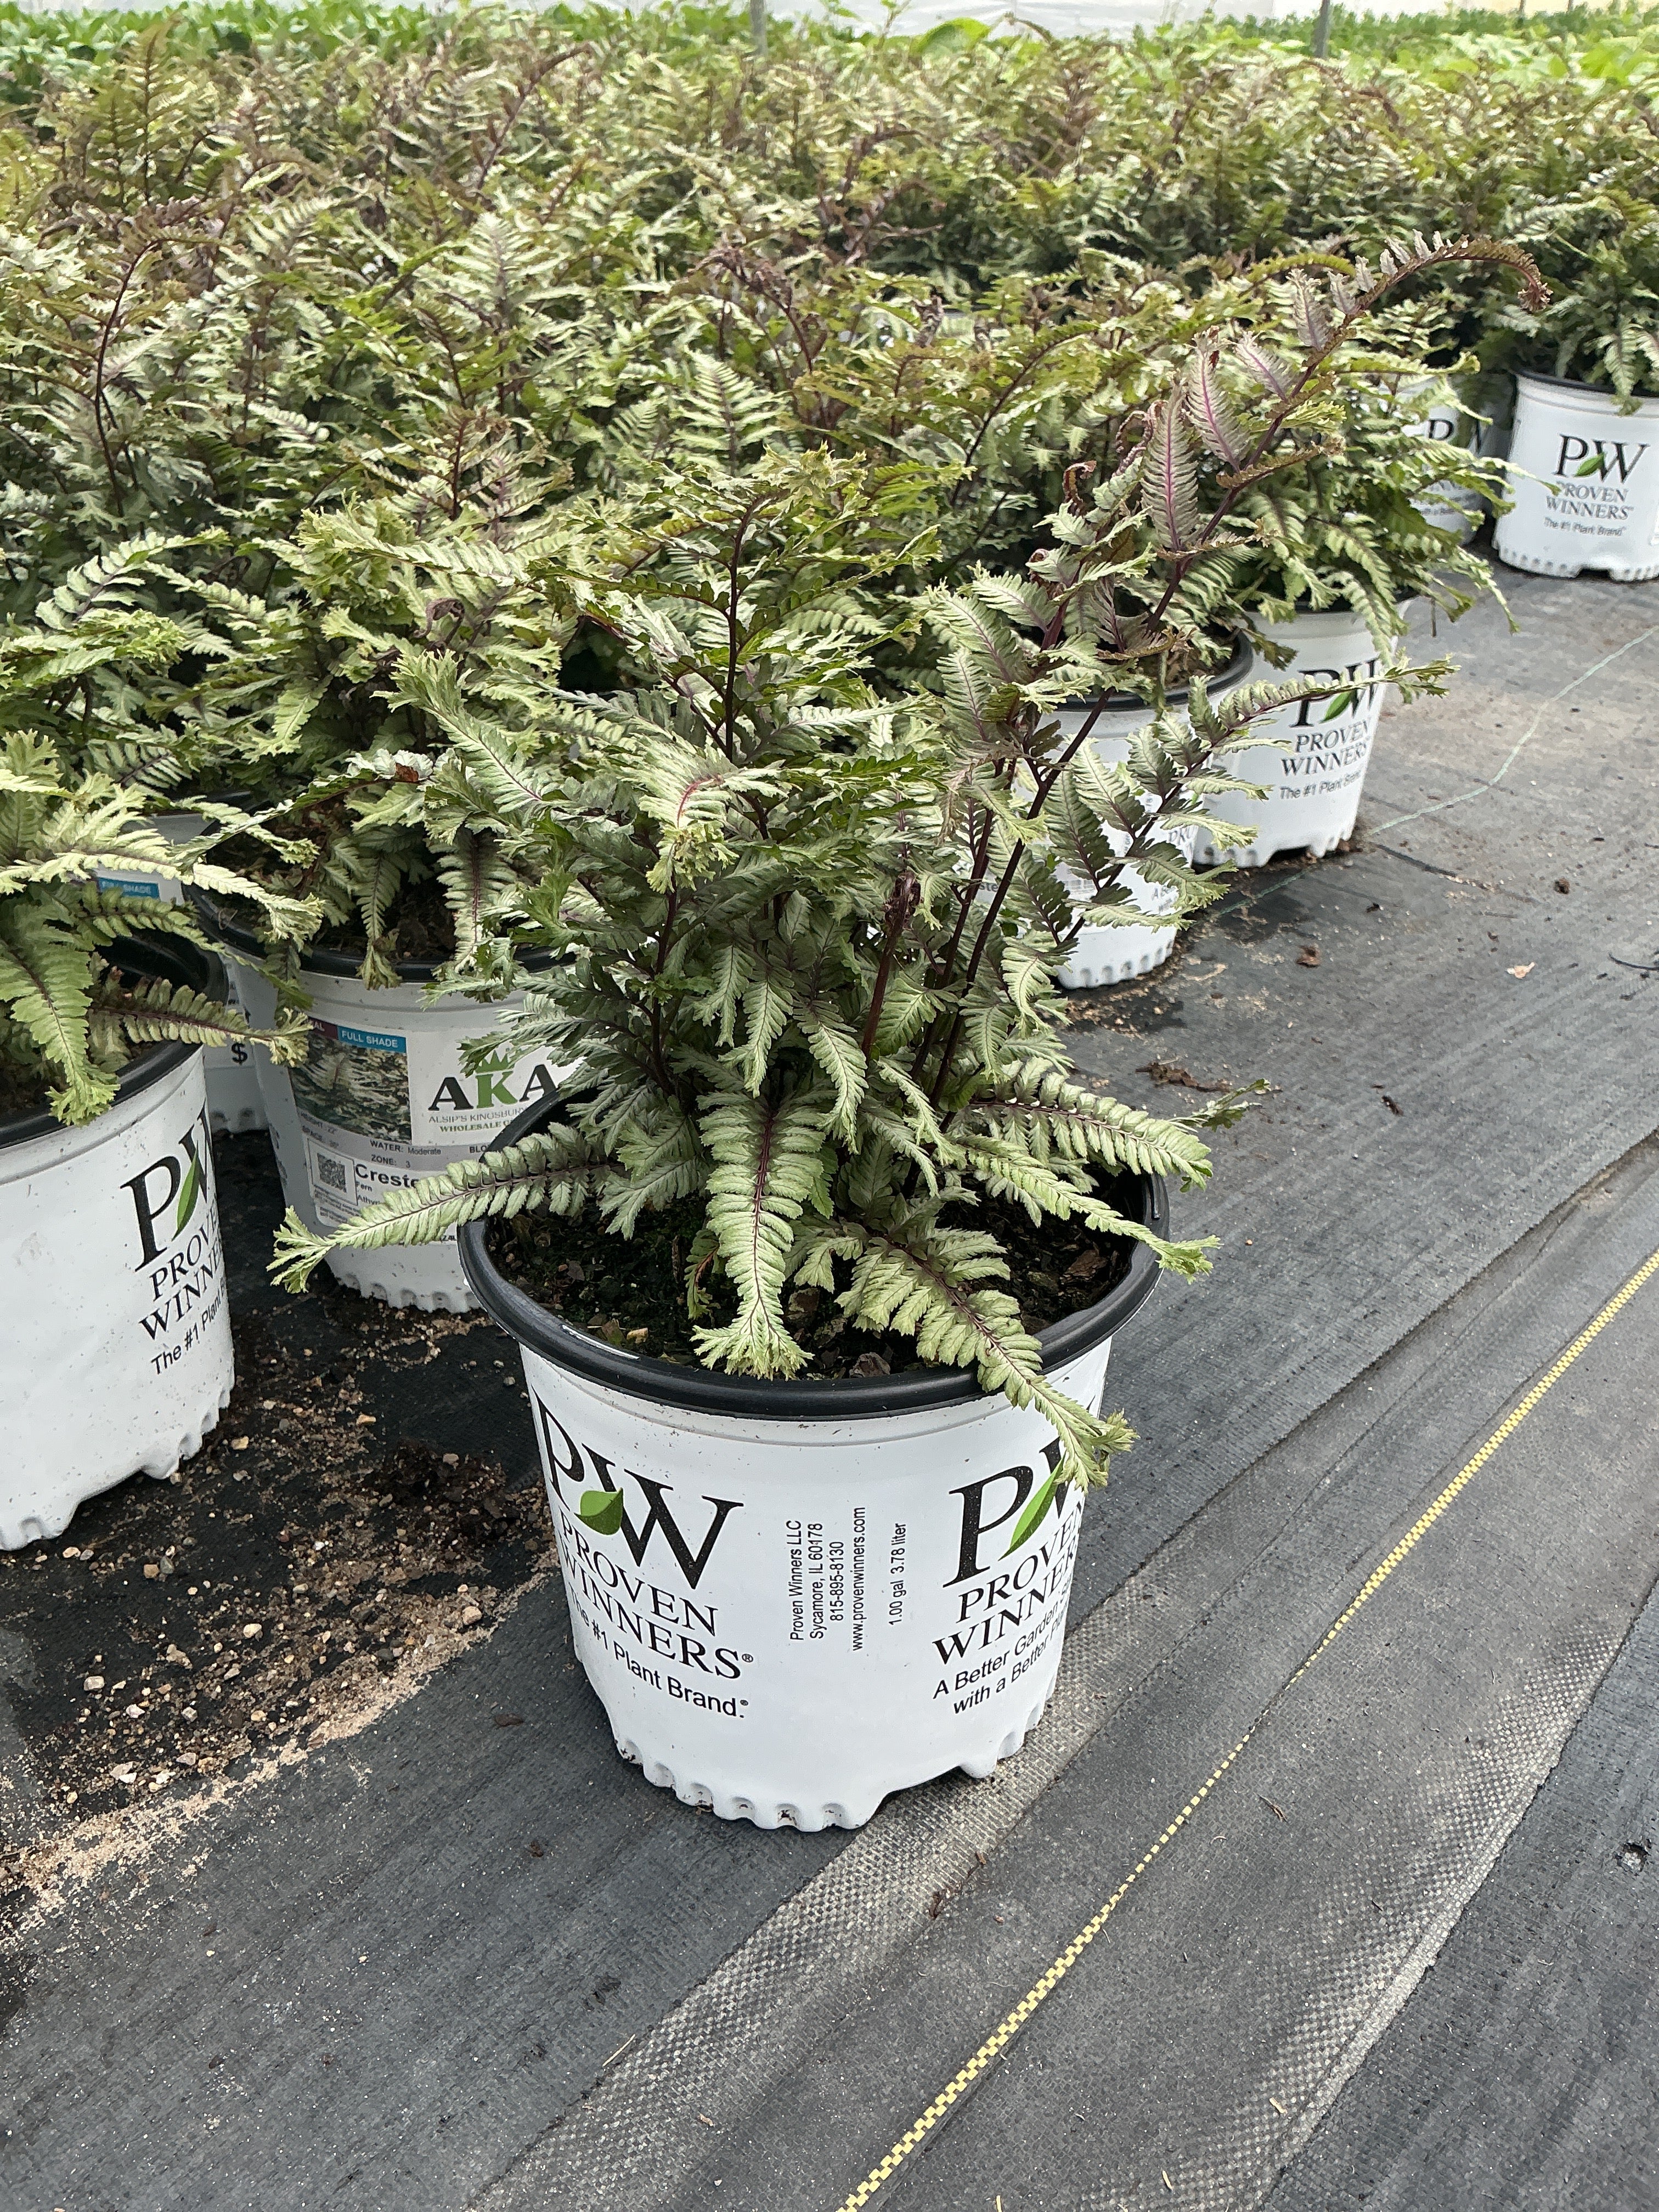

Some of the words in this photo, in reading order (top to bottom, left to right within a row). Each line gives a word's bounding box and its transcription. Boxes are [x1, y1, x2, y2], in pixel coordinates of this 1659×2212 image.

[1551, 433, 1650, 483] PW
[1279, 785, 1300, 800] The
[341, 1030, 364, 1043] FULL
[366, 1035, 398, 1048] SHADE
[427, 1064, 557, 1111] AKA
[370, 1139, 404, 1153] WATER:
[408, 1147, 442, 1155] Moderate
[439, 1122, 499, 1133] WHOLESALE
[356, 1164, 419, 1189] Crest
[371, 1154, 397, 1166] ZONE:
[405, 1160, 411, 1169] 3
[357, 1181, 373, 1192] Fern
[149, 1194, 219, 1302] PROVE
[138, 1227, 222, 1341] WINNE
[151, 1345, 182, 1375] The
[184, 1322, 200, 1351] #1
[527, 1389, 744, 1590] PW
[786, 1520, 802, 1545] LLC
[808, 1523, 823, 1560] 60178
[891, 1523, 906, 1546] liter
[559, 1505, 718, 1637] PROVEN
[789, 1548, 803, 1597] Winners
[809, 1564, 823, 1574] IL
[830, 1541, 844, 1621] 815-895-8130
[853, 1507, 867, 1651] www.provenwinners.com
[890, 1547, 905, 1575] 3.78
[810, 1578, 827, 1639] Sycamore,
[890, 1579, 906, 1598] gal
[932, 1534, 1077, 1666] WINNER
[790, 1600, 804, 1640] Proven
[888, 1601, 902, 1626] 1.00
[568, 1582, 590, 1627] The
[592, 1618, 608, 1650] #1
[613, 1640, 663, 1690] Plant
[933, 1679, 949, 1700] A
[954, 1651, 1010, 1691] Better
[1014, 1601, 1058, 1656] Garden
[953, 1687, 990, 1714] with
[996, 1680, 1006, 1693] a
[1011, 1634, 1049, 1684] Better
